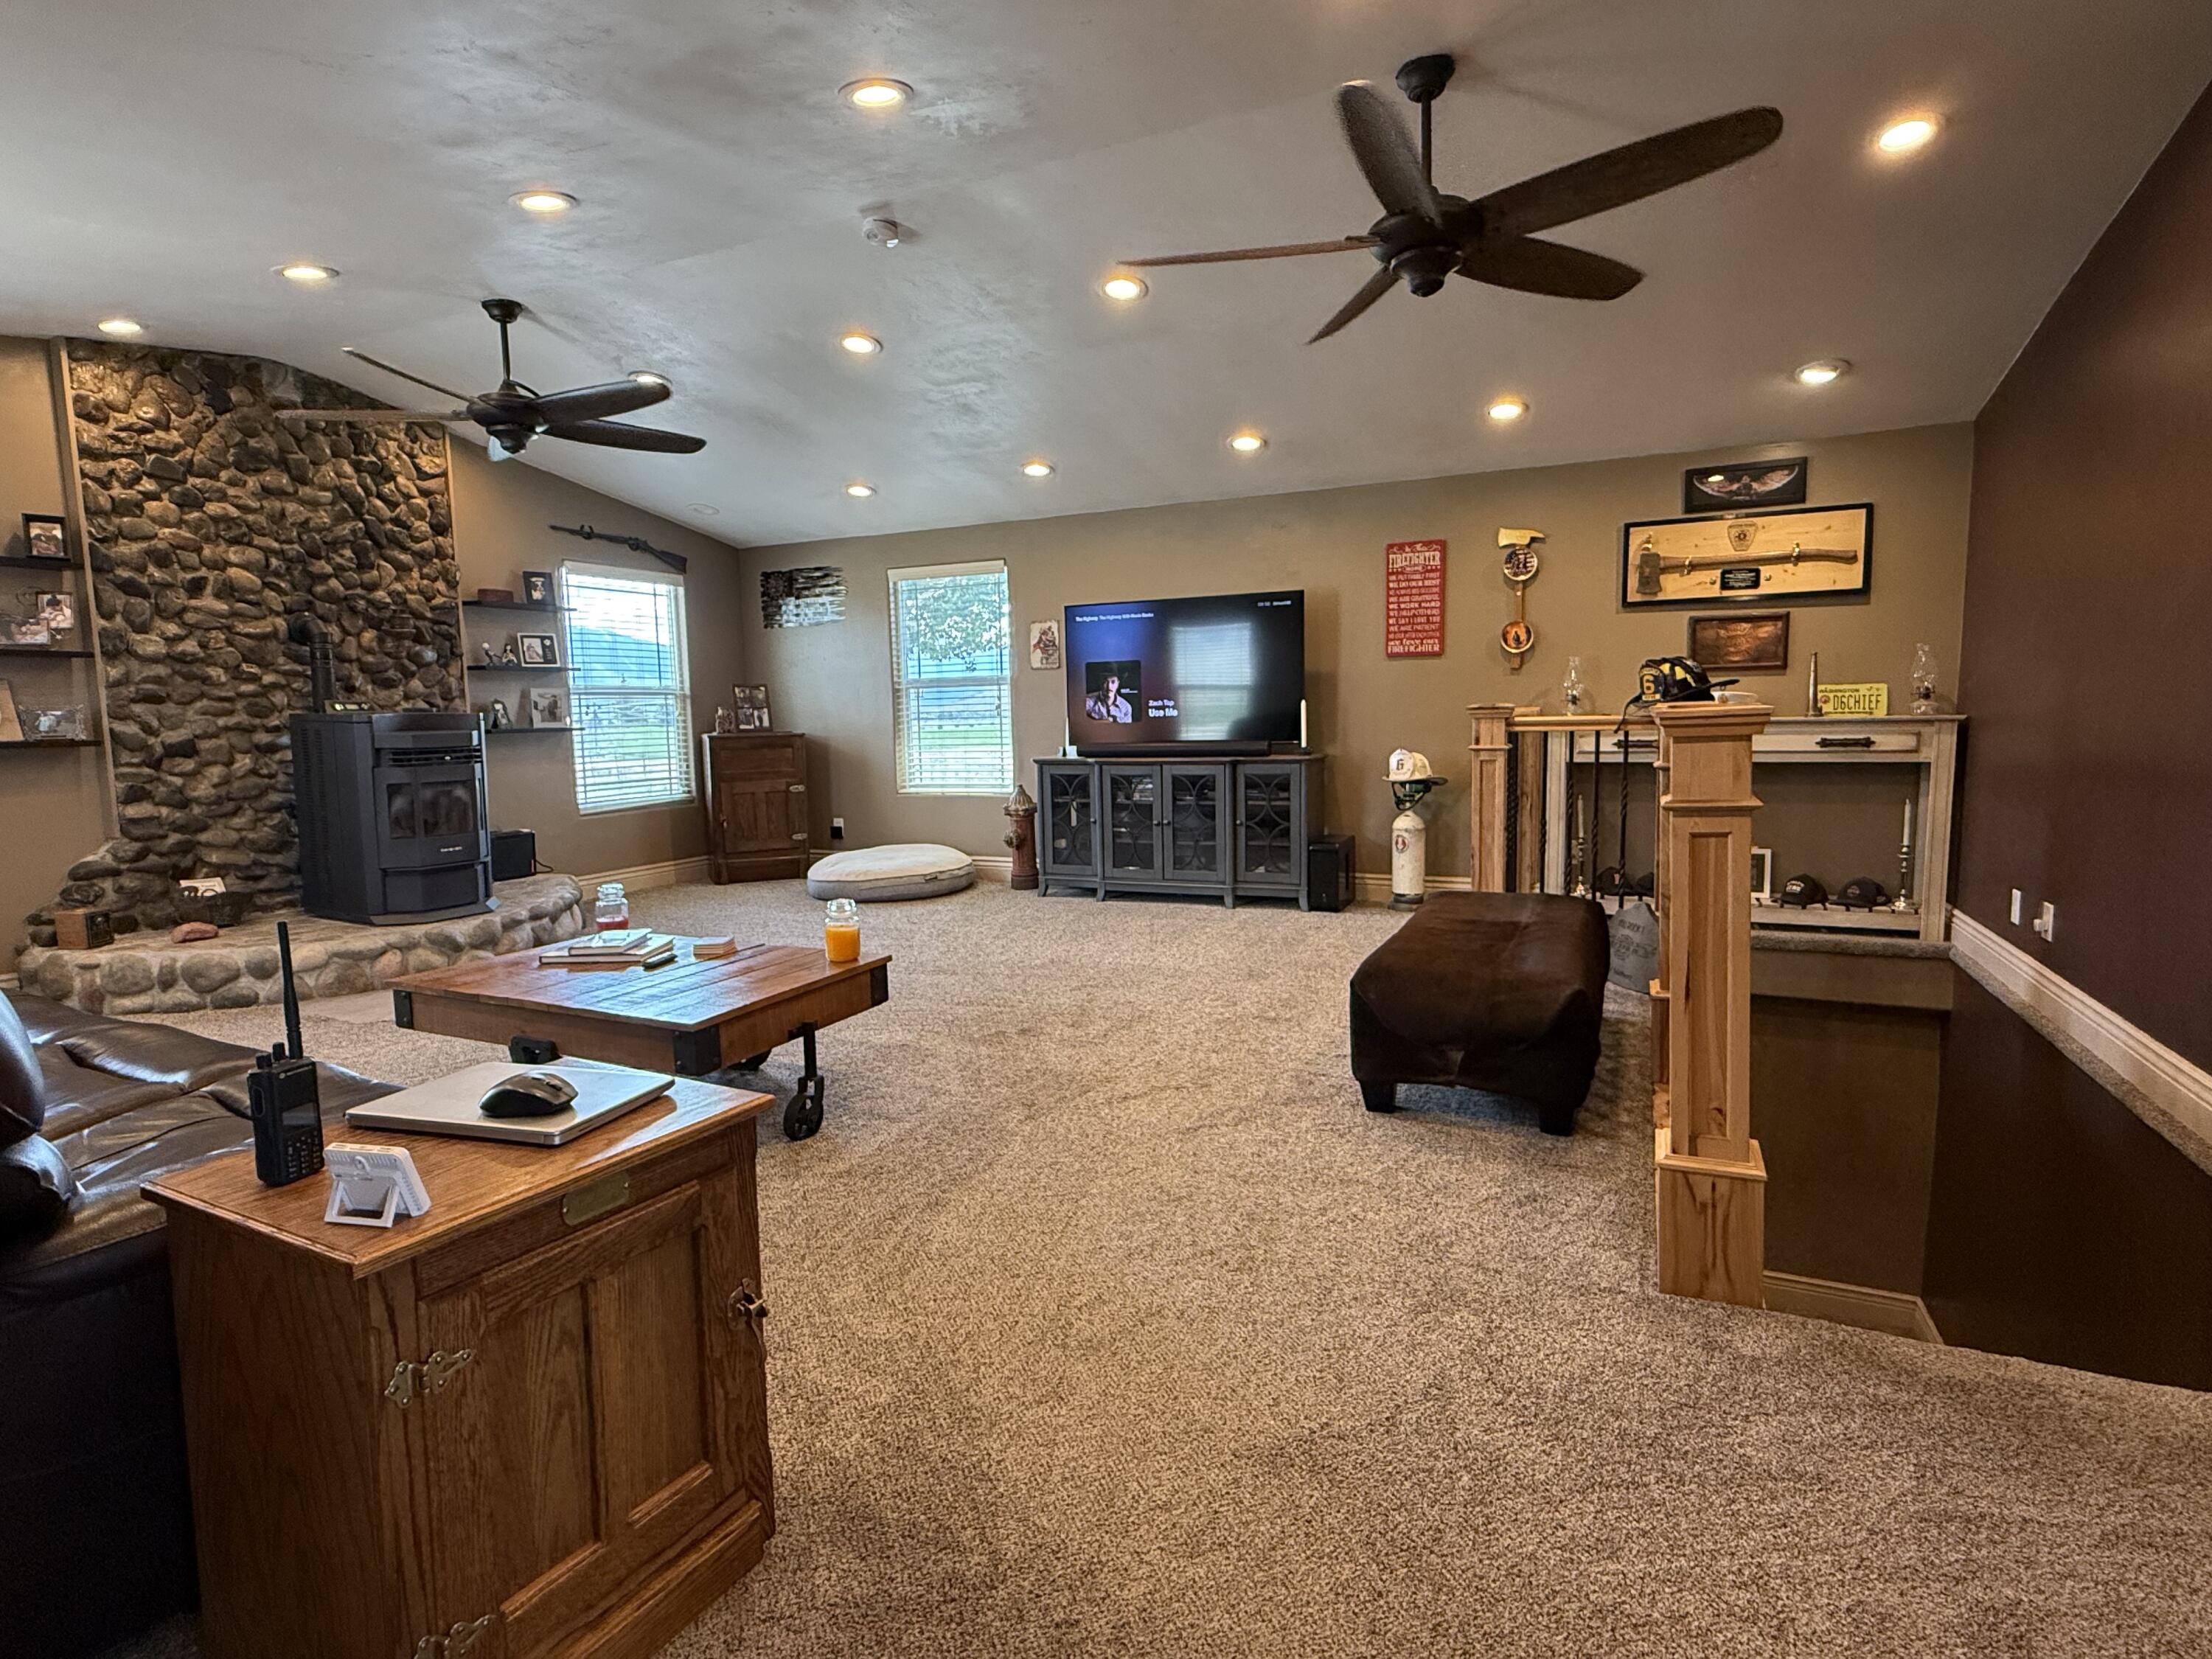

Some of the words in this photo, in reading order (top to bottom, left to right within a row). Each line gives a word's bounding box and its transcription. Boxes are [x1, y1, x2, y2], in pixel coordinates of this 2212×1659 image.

[1388, 551, 1440, 568] FIREFIGHTER
[1388, 644, 1440, 653] FIREFIGHTER
[1643, 675, 1655, 694] 6
[1833, 694, 1882, 711] D6CHIEF
[1148, 709, 1164, 717] Use
[1165, 708, 1178, 717] Me
